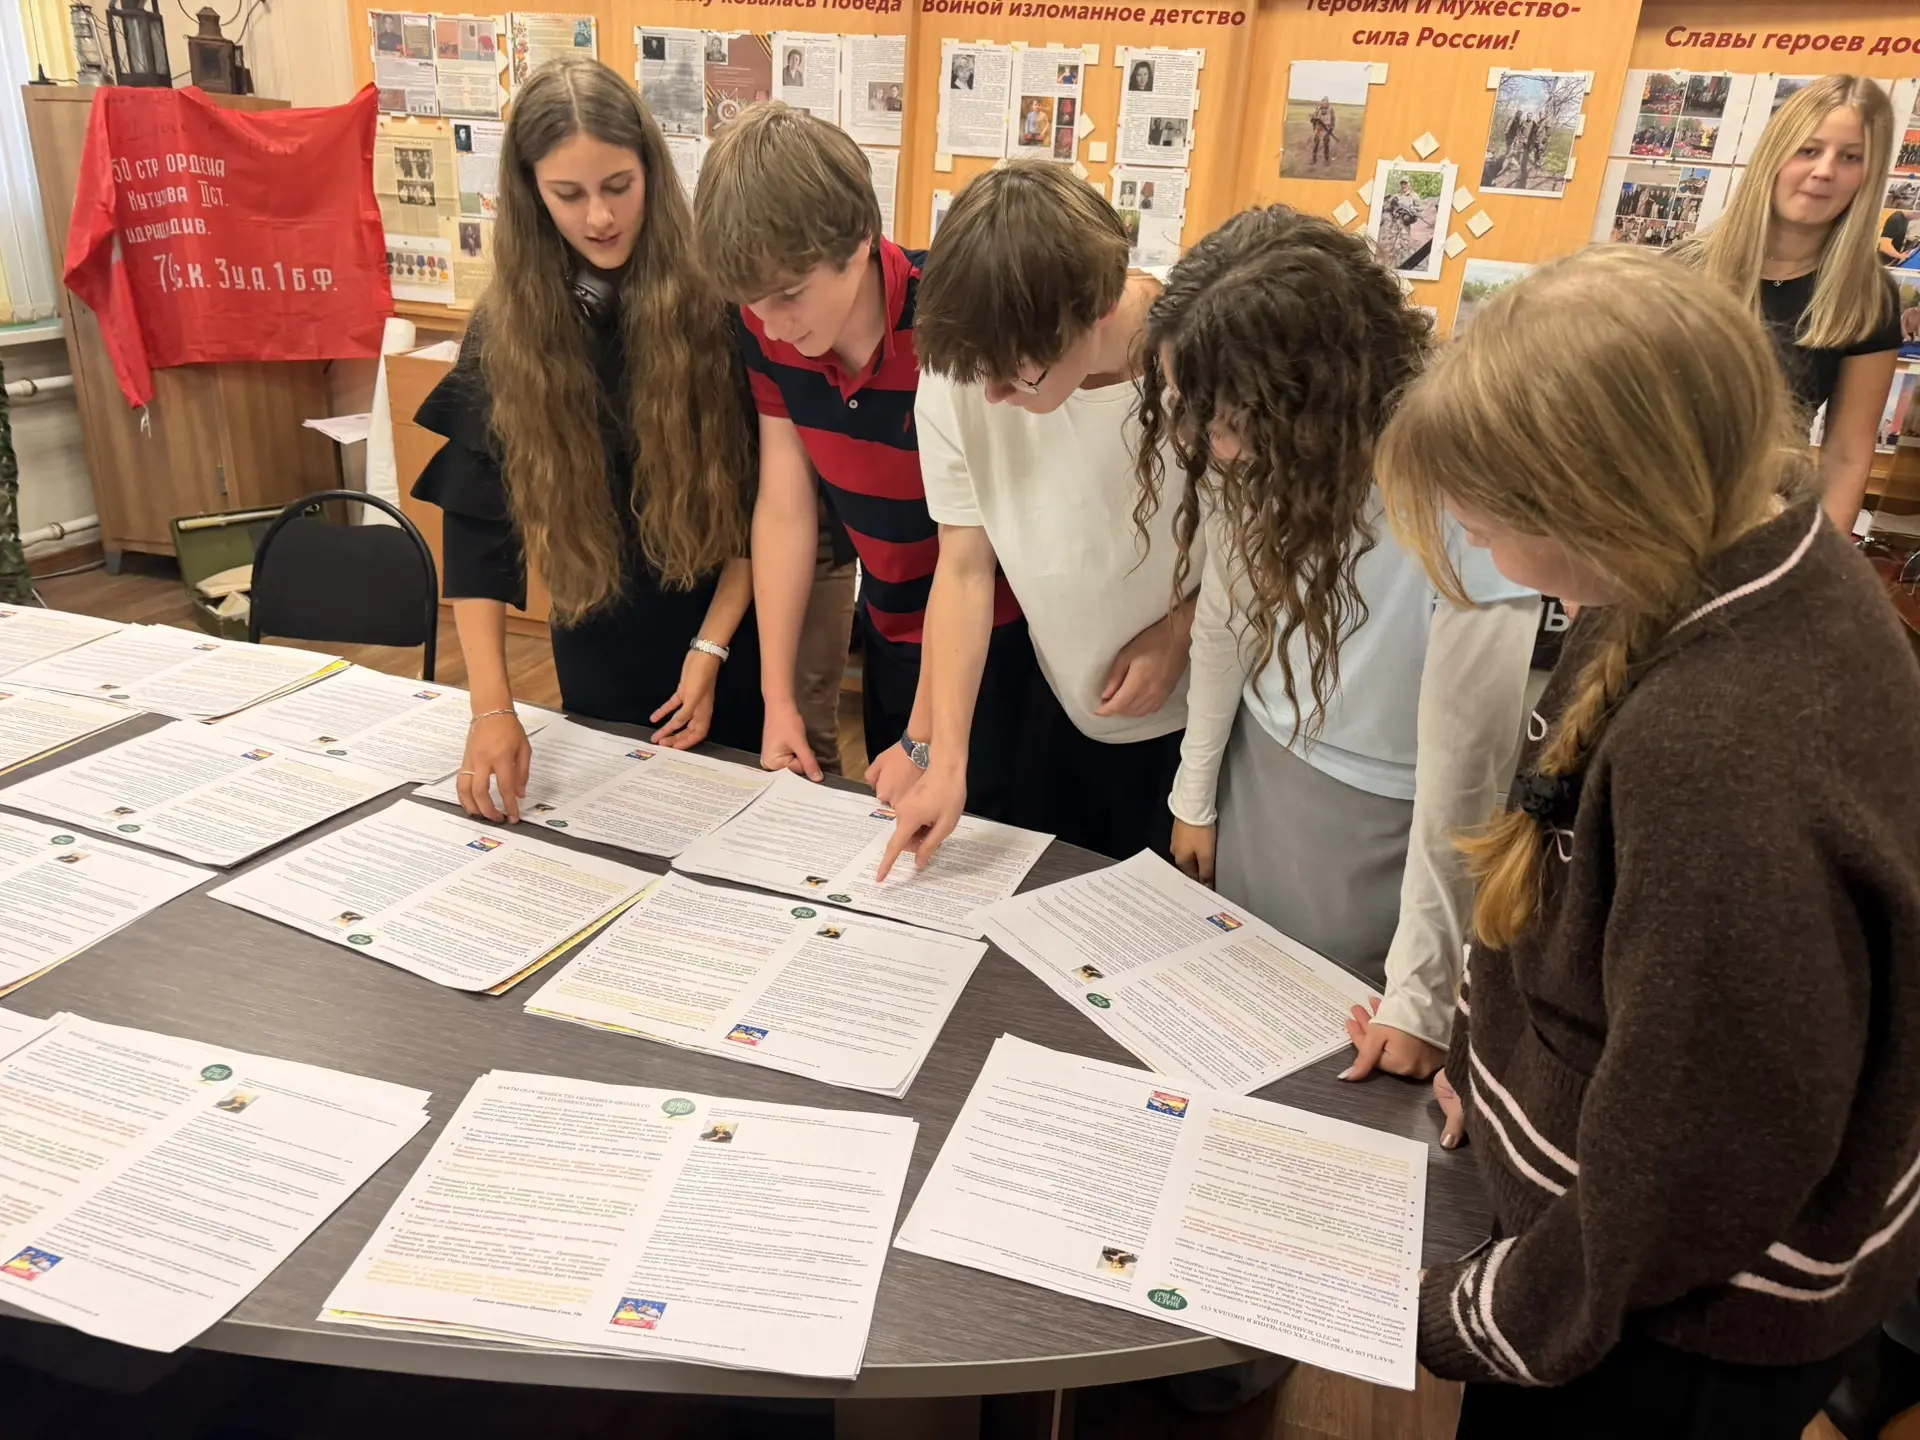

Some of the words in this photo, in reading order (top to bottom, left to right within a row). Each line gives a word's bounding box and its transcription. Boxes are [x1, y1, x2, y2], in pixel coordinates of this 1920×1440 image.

[1009, 2, 1146, 22] изломанное
[1149, 8, 1246, 26] детство
[1436, 0, 1582, 20] мужество-
[1352, 29, 1410, 46] сила
[1415, 27, 1521, 50] России!
[1665, 26, 1756, 48] Славы
[1762, 33, 1865, 55] героев
